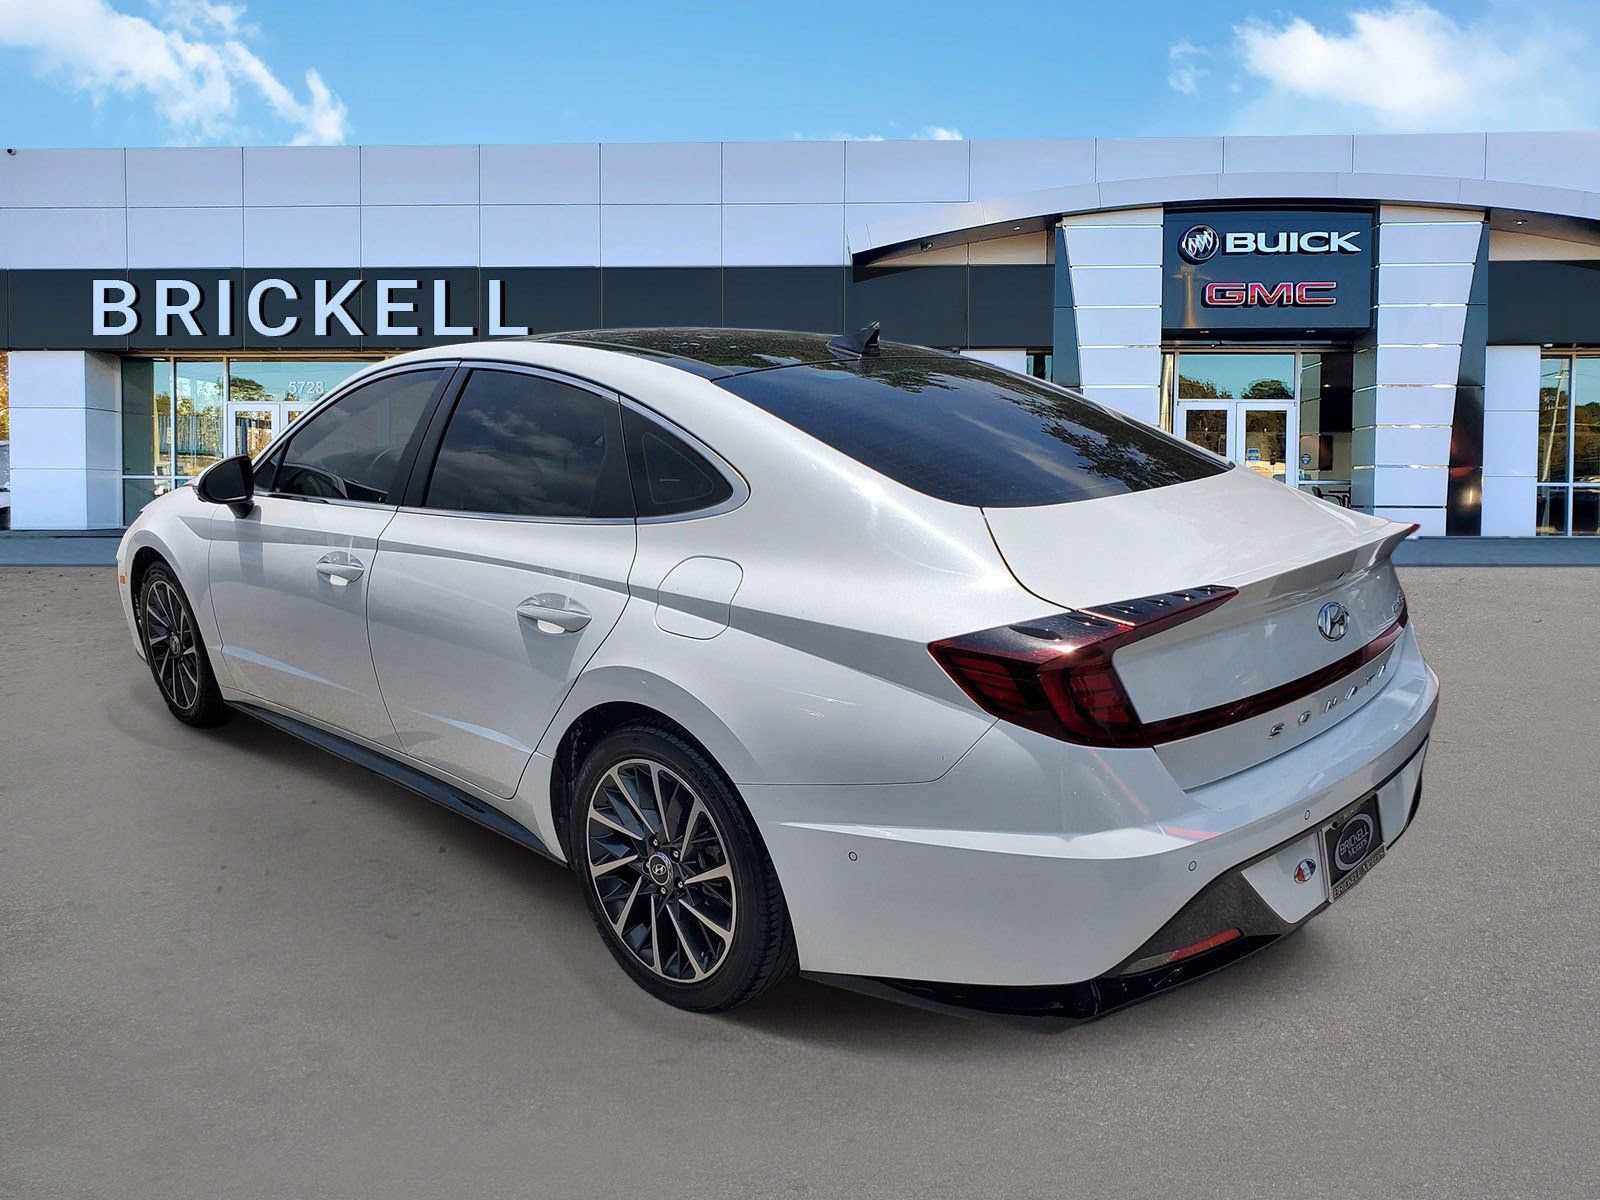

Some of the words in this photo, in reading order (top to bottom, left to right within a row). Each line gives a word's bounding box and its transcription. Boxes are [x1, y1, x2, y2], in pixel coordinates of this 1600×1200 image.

[1225, 231, 1362, 254] BUICK
[1204, 281, 1337, 305] GMC
[92, 278, 532, 337] BRICKELL
[288, 380, 326, 395] 5728
